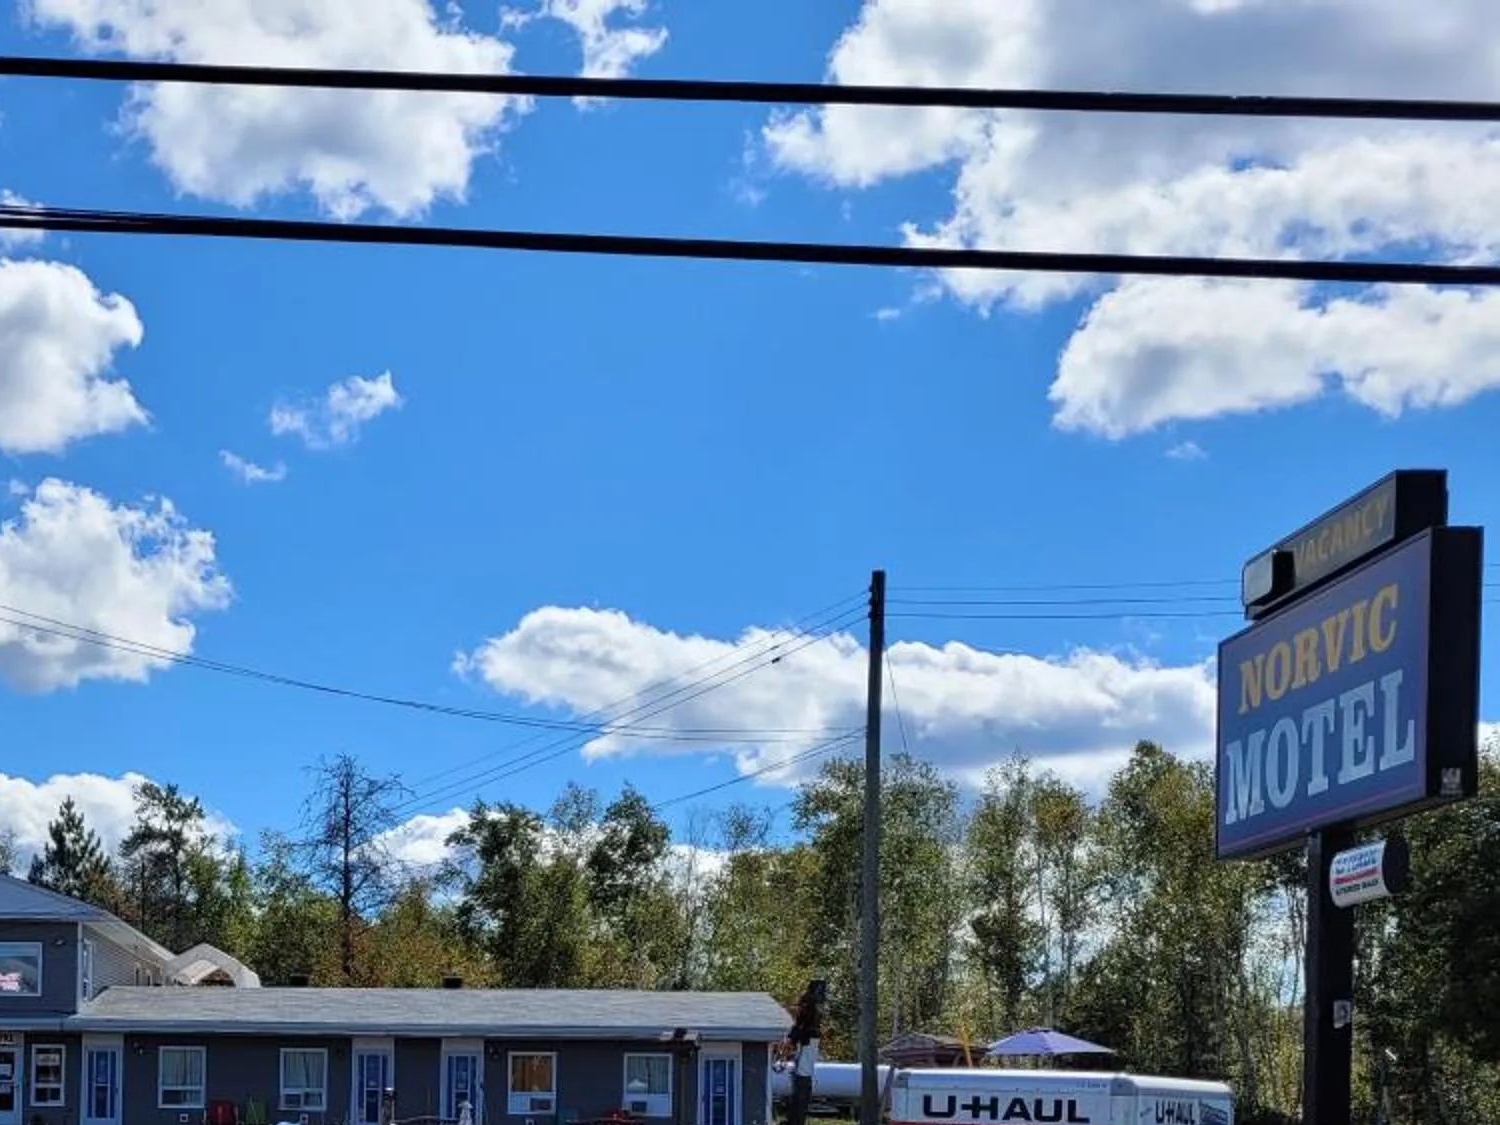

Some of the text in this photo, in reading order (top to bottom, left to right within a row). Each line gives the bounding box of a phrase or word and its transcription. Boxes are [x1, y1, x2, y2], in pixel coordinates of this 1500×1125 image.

[1238, 583, 1399, 715] NORVIC
[1225, 668, 1415, 825] MOTEL
[923, 1094, 1090, 1124] U-HAUL
[1155, 1100, 1195, 1125] U-HAUL
